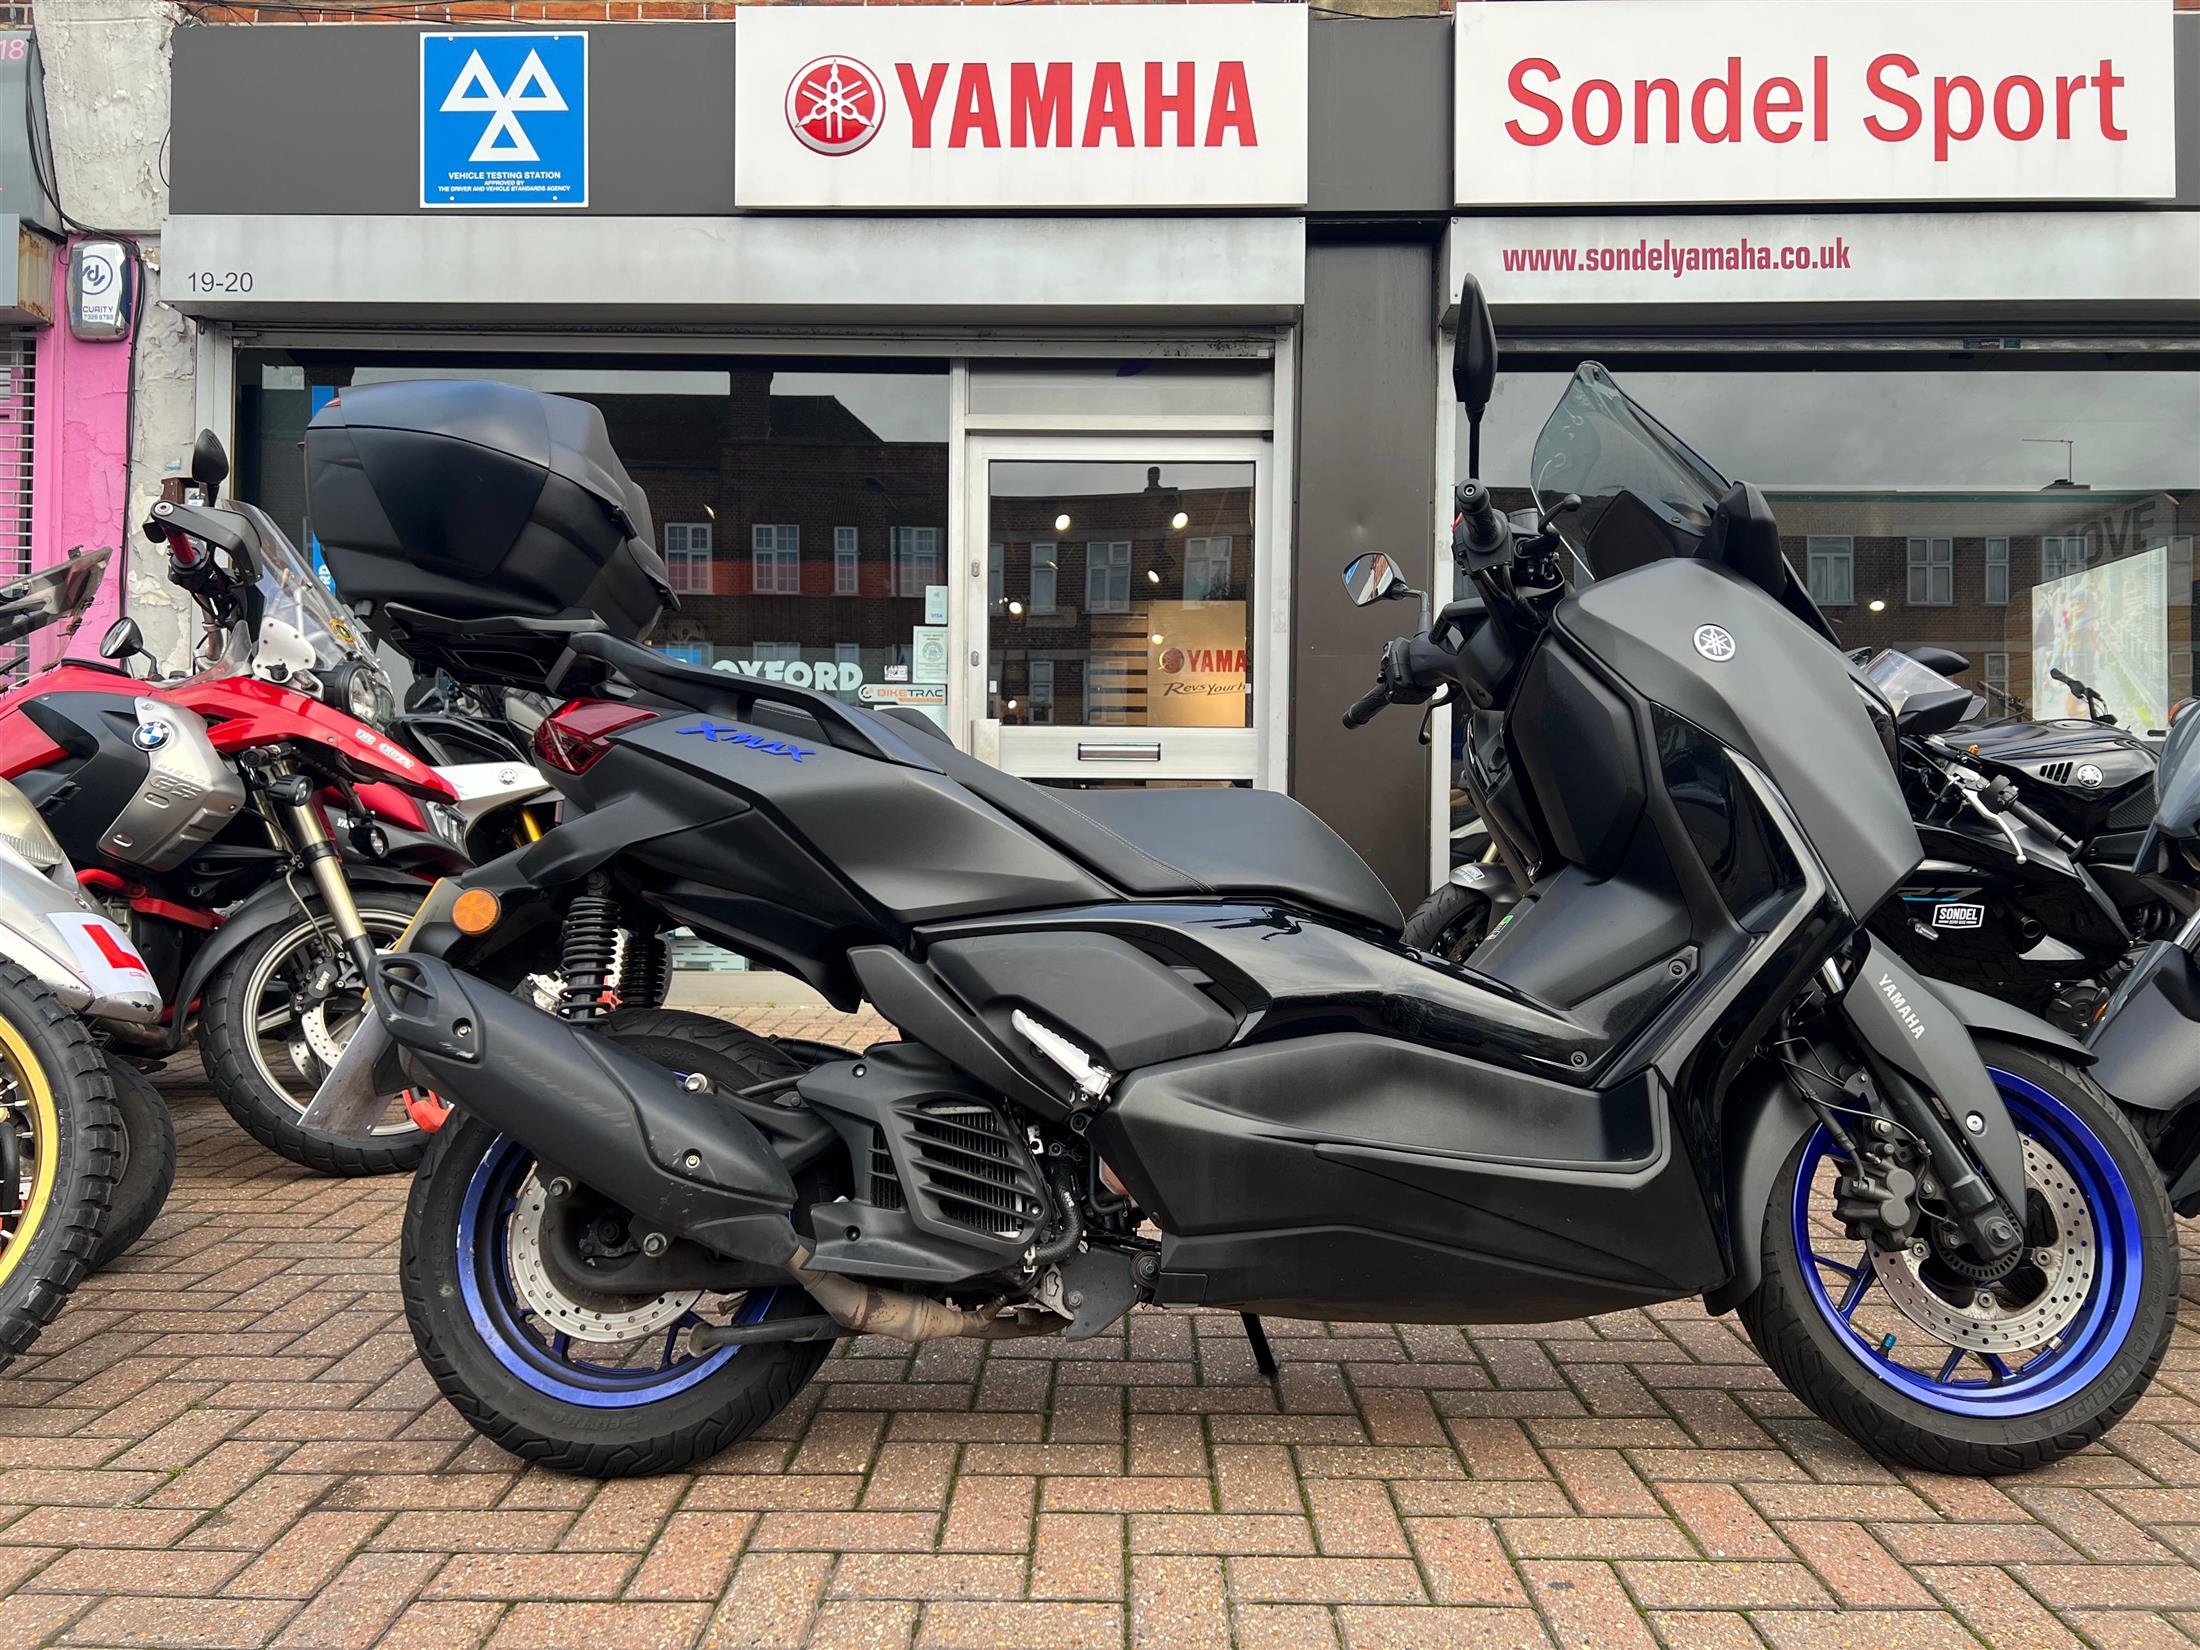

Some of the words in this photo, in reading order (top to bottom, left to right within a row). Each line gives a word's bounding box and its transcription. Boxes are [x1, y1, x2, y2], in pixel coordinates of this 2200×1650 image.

[894, 61, 1258, 148] YAMAHA
[1504, 55, 1829, 147] Sondel
[1863, 53, 2128, 162] Sport
[448, 172, 484, 180] VEHICLE
[524, 171, 561, 179] STATION
[1502, 236, 1851, 278] www.sondelyamaha.co.uk
[188, 272, 253, 292] 19-20
[877, 689, 943, 698] BIKETRAC
[1163, 682, 1206, 696] Revs
[1939, 907, 1978, 920] SONDEL
[315, 970, 331, 991] BMW
[1879, 973, 1925, 1040] YAMAHA
[2050, 1363, 2131, 1435] MICHELIN
